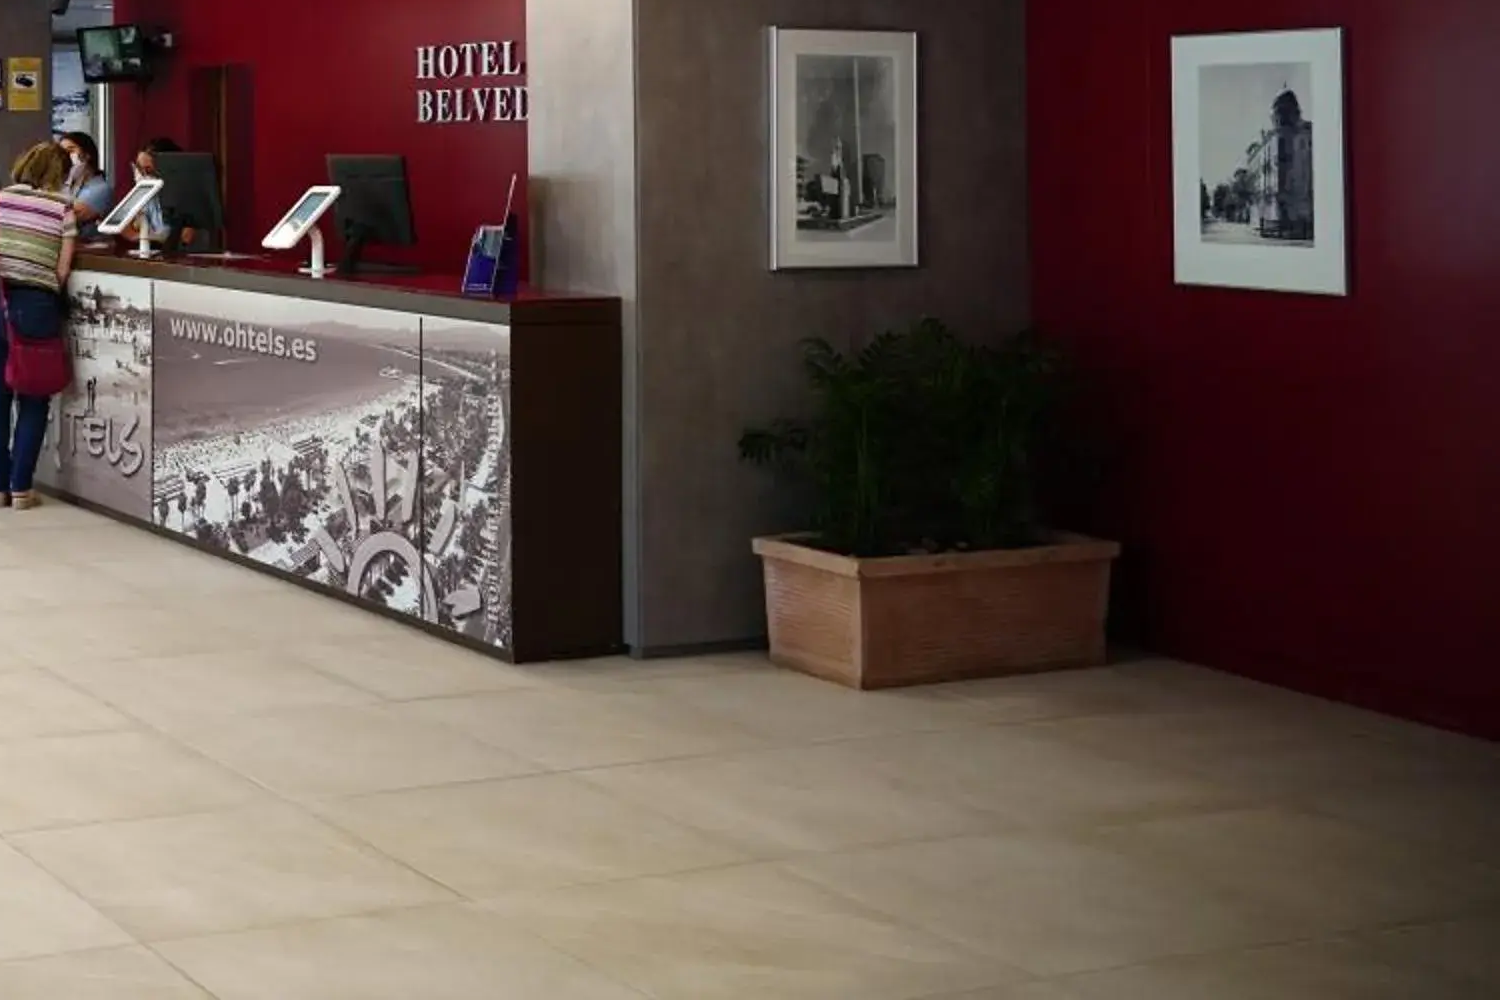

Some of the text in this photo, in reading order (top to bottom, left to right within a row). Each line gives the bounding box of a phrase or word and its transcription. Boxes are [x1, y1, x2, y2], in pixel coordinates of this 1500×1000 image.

[416, 40, 520, 79] HOTEL
[417, 86, 528, 123] BELVED
[170, 317, 317, 361] www.ohtels.es
